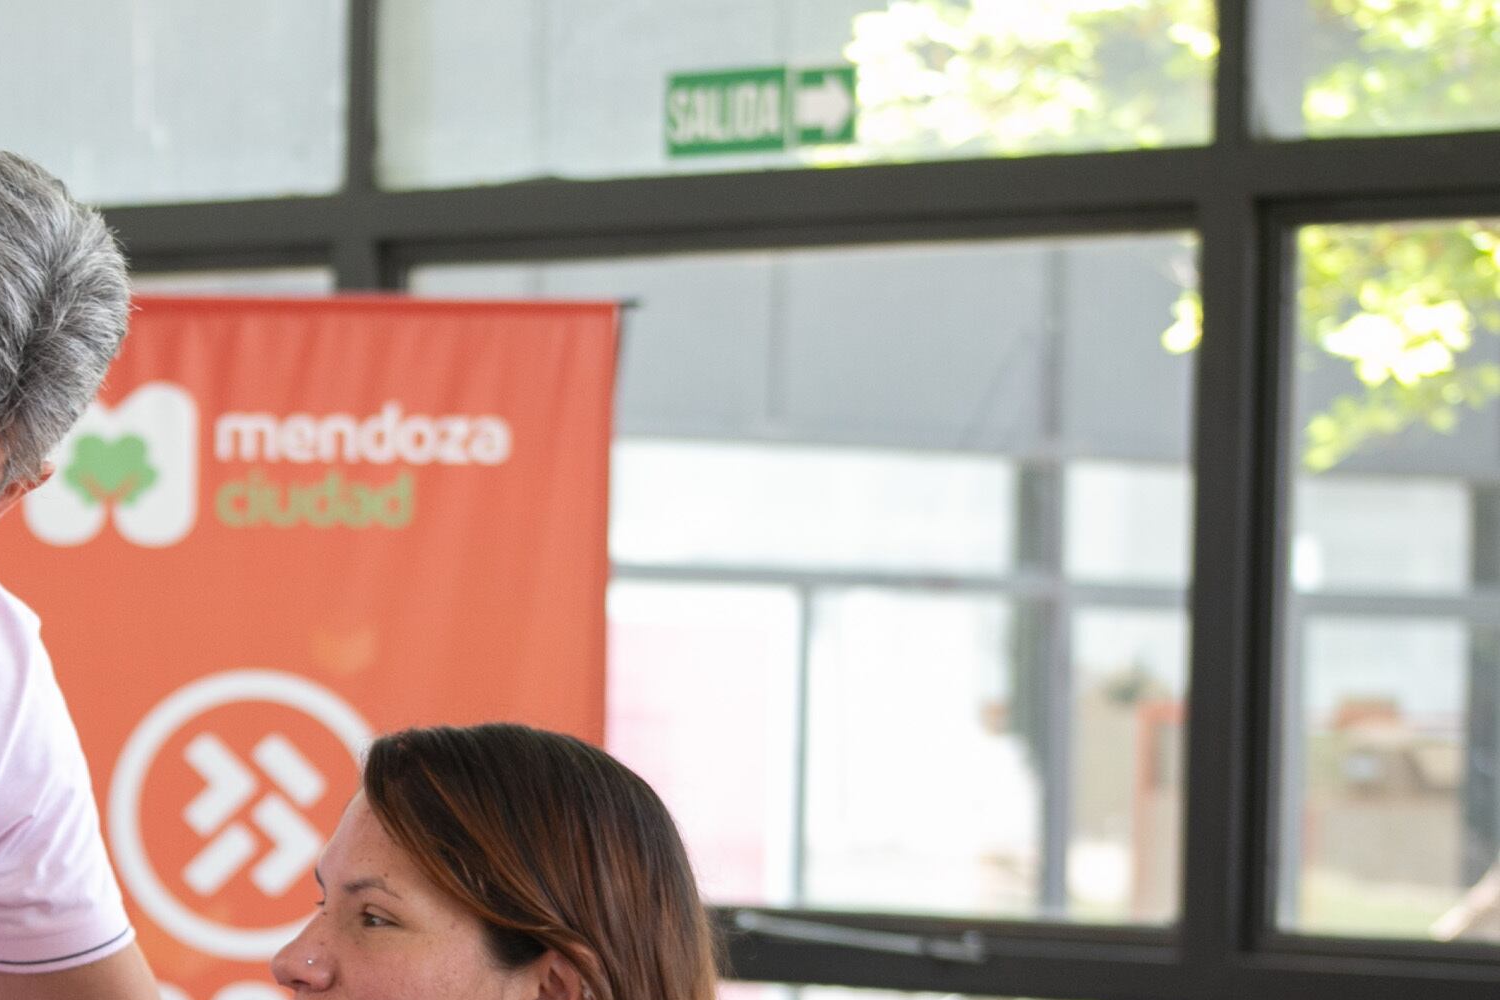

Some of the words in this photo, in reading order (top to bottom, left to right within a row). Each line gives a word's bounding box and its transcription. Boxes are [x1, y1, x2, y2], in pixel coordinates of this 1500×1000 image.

[671, 82, 780, 143] SALIDA
[214, 402, 510, 465] mendoza
[216, 469, 413, 528] ciudad
